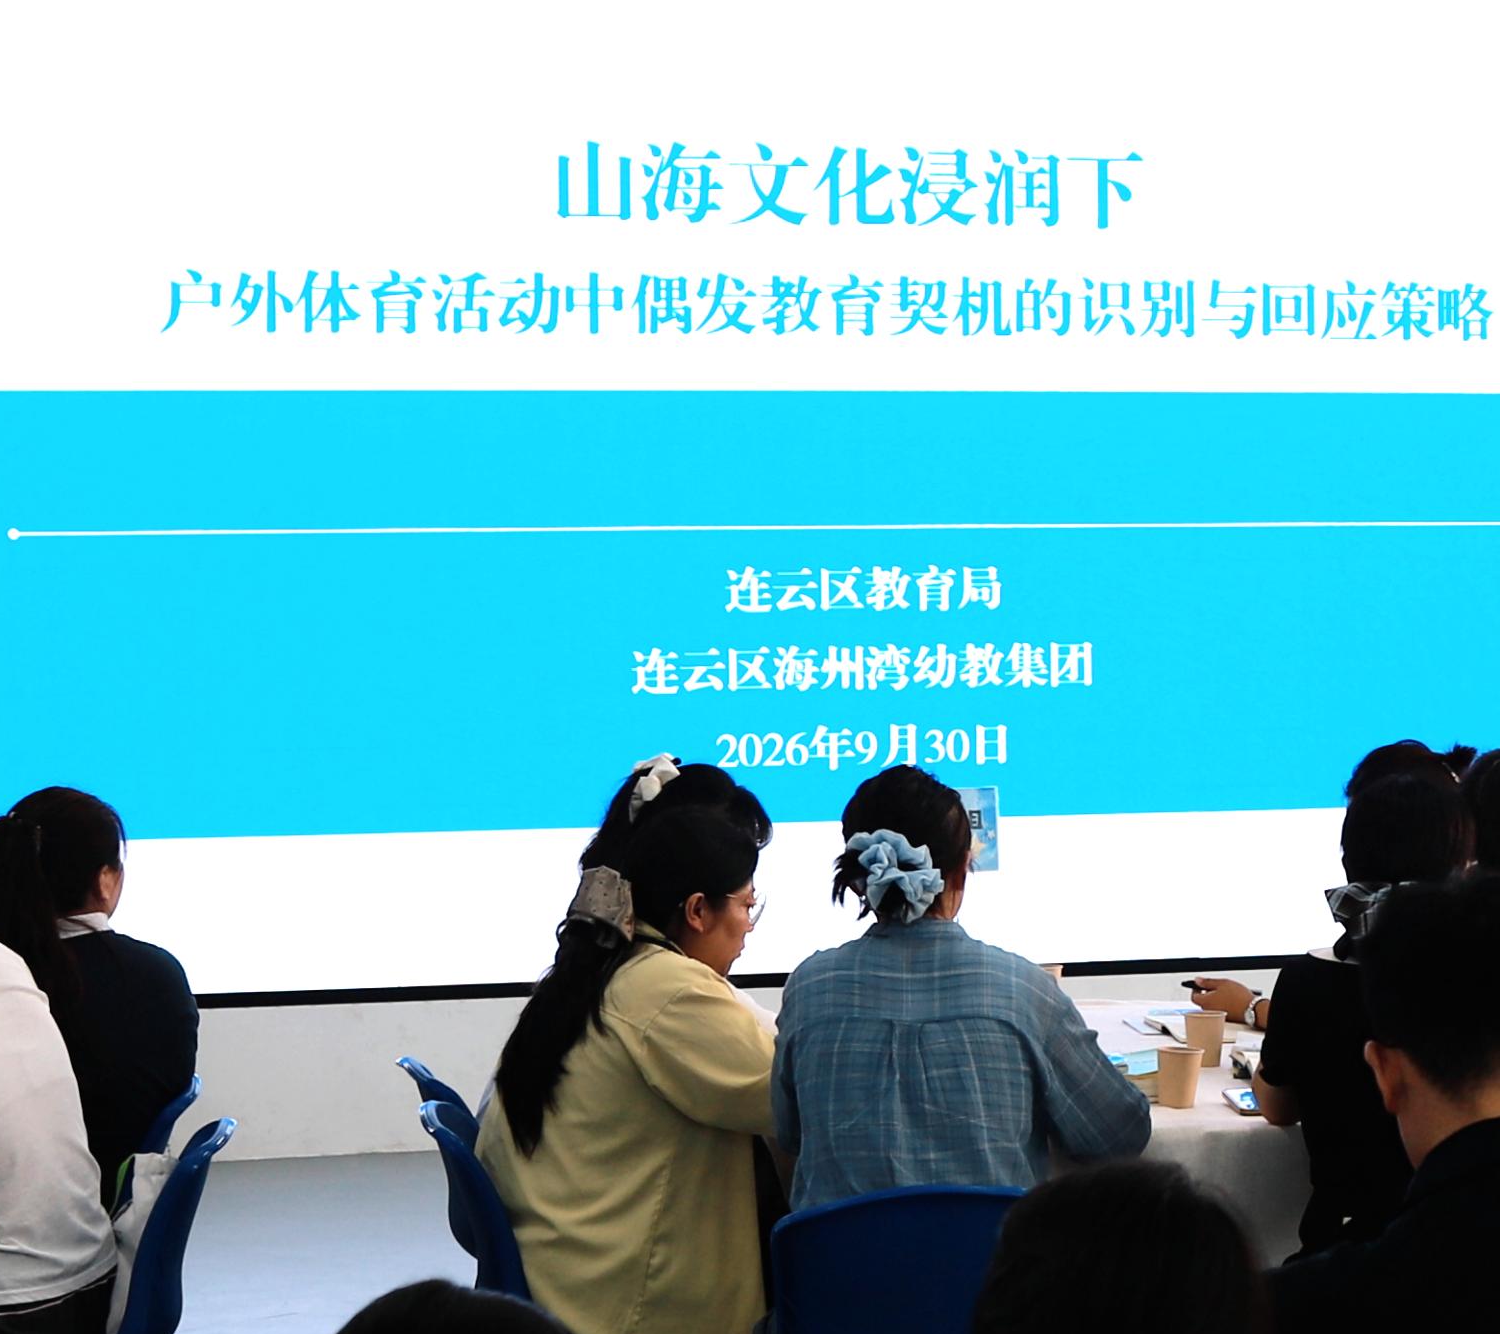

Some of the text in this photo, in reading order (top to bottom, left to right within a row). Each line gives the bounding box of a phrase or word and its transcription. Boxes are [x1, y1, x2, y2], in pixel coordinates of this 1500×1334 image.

[557, 141, 1143, 229] 山海文化浸润下
[161, 269, 1493, 342] 户外体育活动中偶发教育契机的识别与回应策略
[725, 565, 1002, 613] 连云区教育局
[632, 641, 1093, 694] 连云区海州湾幼教集团
[716, 723, 1008, 771] 2026年9月30日
